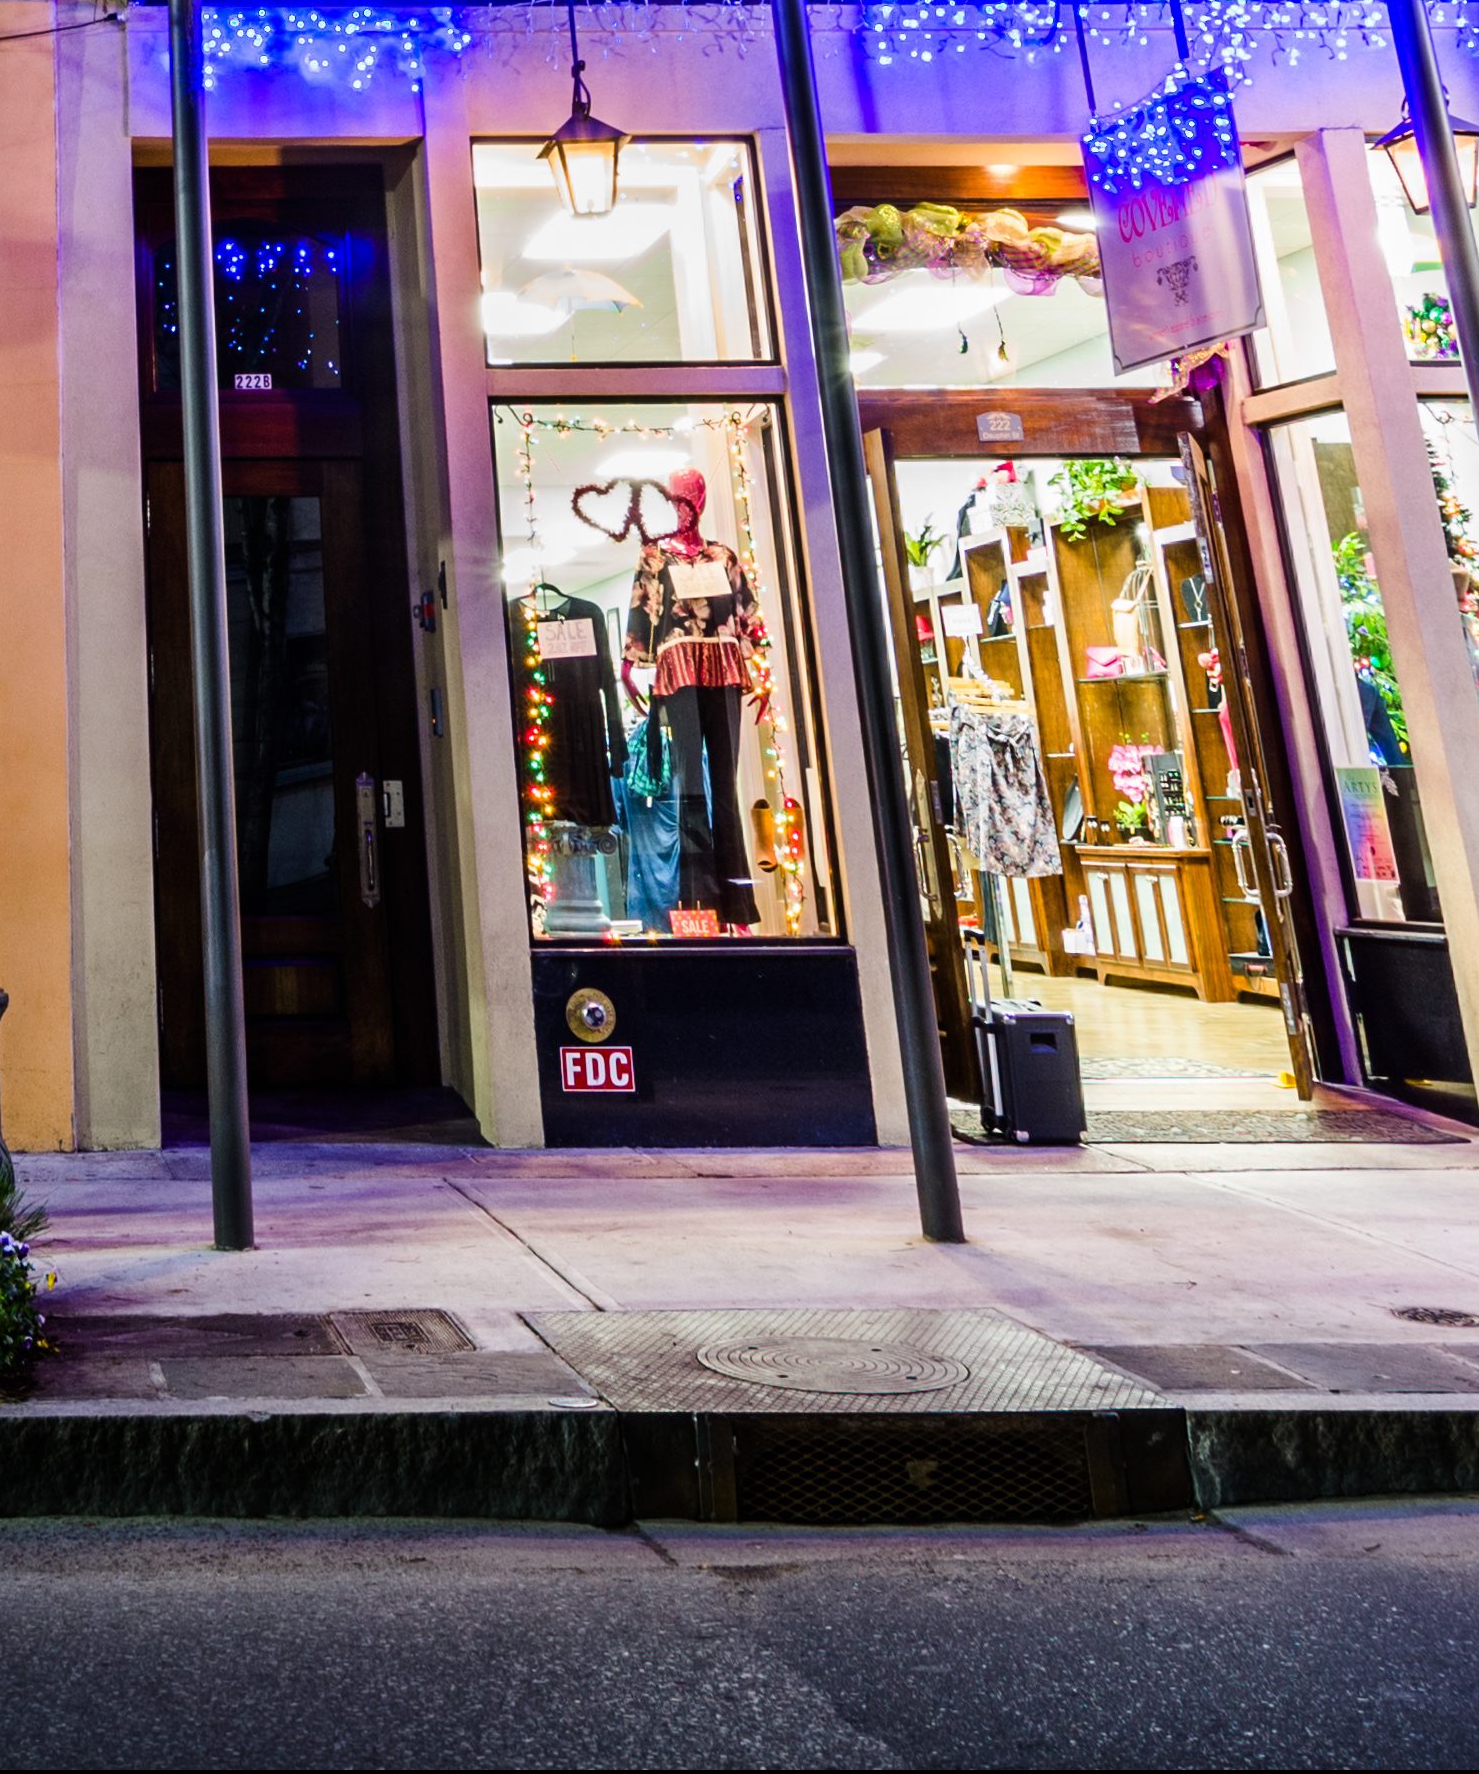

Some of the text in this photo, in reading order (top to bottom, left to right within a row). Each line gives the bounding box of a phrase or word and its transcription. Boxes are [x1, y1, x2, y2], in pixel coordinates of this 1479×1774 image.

[236, 375, 271, 388] 222B
[988, 420, 1011, 431] 222
[681, 919, 710, 934] SALE
[565, 1052, 630, 1087] FDC
